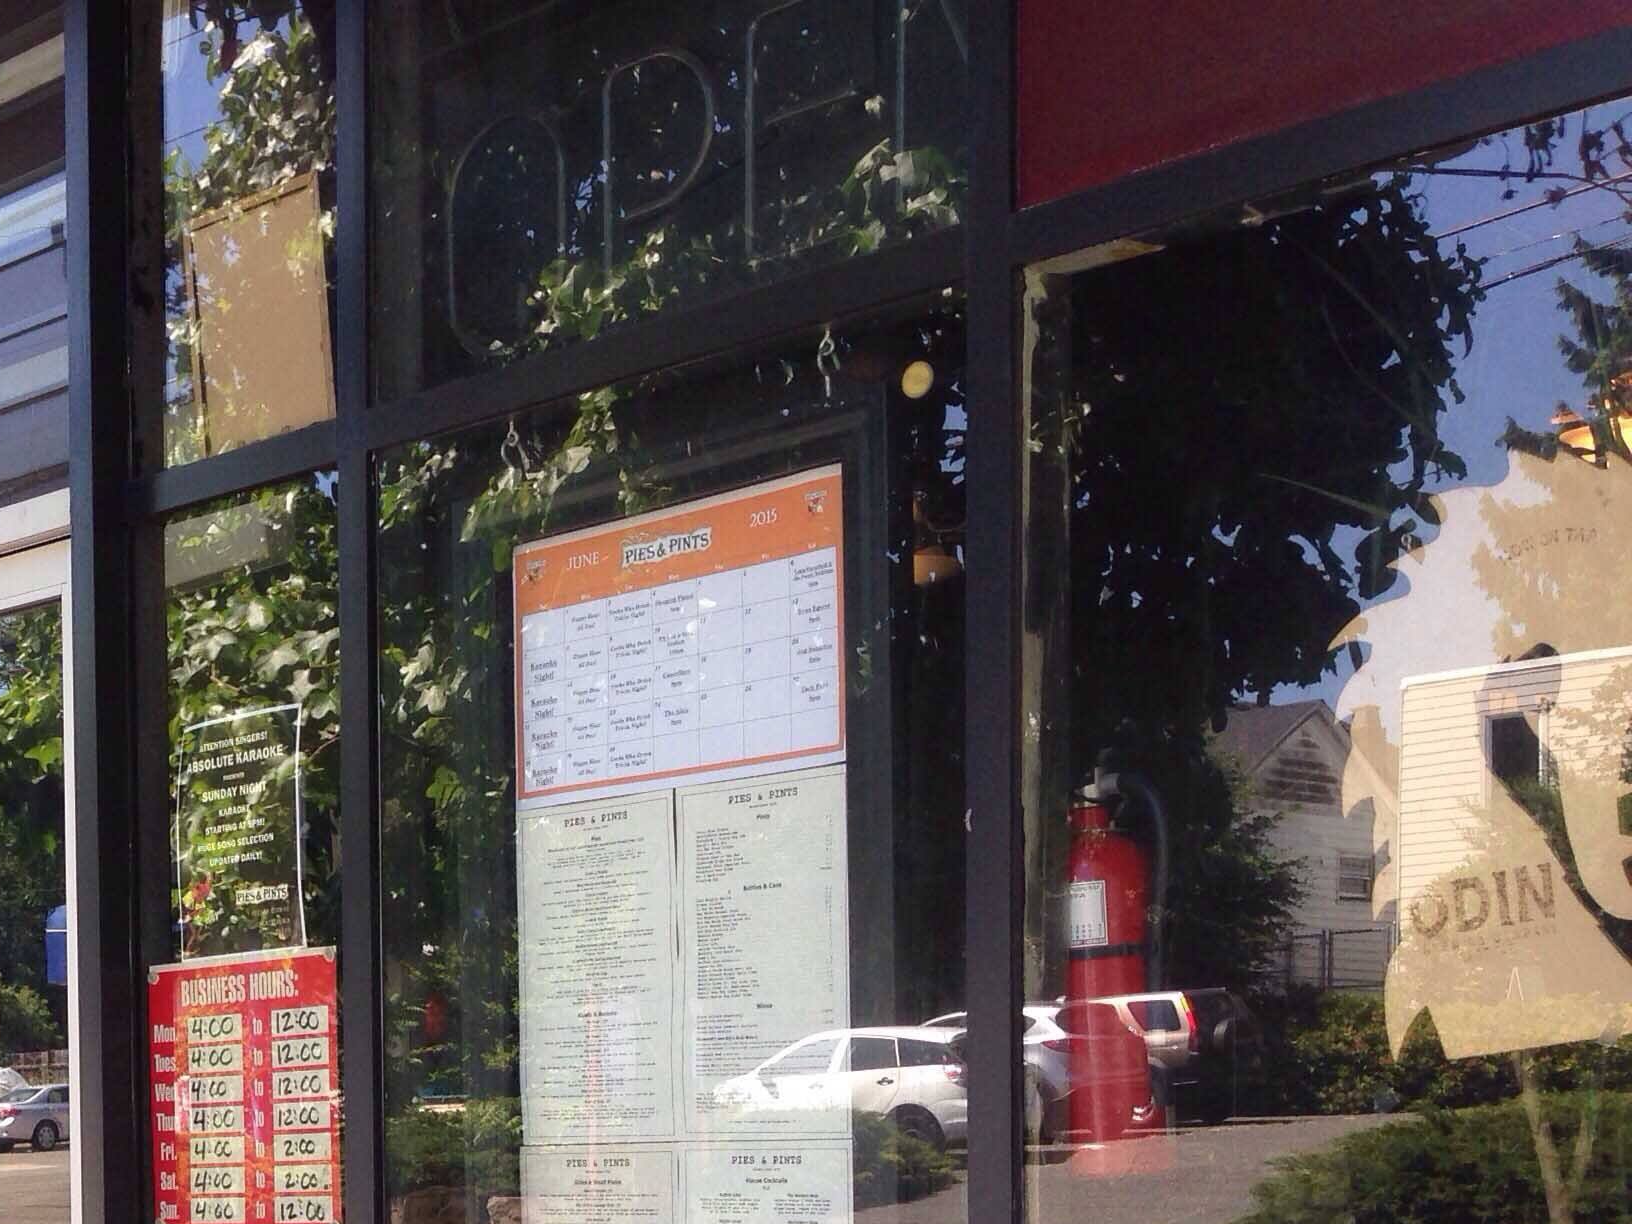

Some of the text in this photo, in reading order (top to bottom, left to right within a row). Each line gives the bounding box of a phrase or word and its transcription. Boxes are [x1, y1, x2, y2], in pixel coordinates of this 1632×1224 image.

[566, 551, 600, 570] JUNE
[624, 533, 710, 564] PIES & PINTS
[186, 744, 284, 774] ABSOLUTE KARAOKE
[201, 781, 267, 803] SUNDAY NIGHT
[769, 787, 798, 799] PINTS
[1410, 862, 1556, 939] ODIN
[180, 968, 299, 1007] BUSINESS HOURS:
[192, 1017, 234, 1040] 4:00
[253, 1018, 263, 1035] to
[275, 1011, 319, 1033] 12:00
[192, 1048, 233, 1068] 4:00
[253, 1048, 263, 1066] to
[277, 1042, 322, 1065] 12:00
[191, 1080, 227, 1101] 4:00
[254, 1079, 264, 1096] to
[277, 1075, 321, 1096] 12:00
[193, 1109, 234, 1131] 4:00
[255, 1110, 264, 1127] to
[278, 1107, 319, 1126] 12:00
[194, 1141, 233, 1160] 4:00
[255, 1141, 265, 1158] to
[284, 1139, 316, 1156] 2:00
[194, 1171, 232, 1192] 4:00
[256, 1171, 265, 1188] to
[285, 1174, 318, 1190] 2:00
[195, 1201, 234, 1219] 4:00
[256, 1201, 266, 1219] to
[280, 1201, 325, 1221] 12:00
